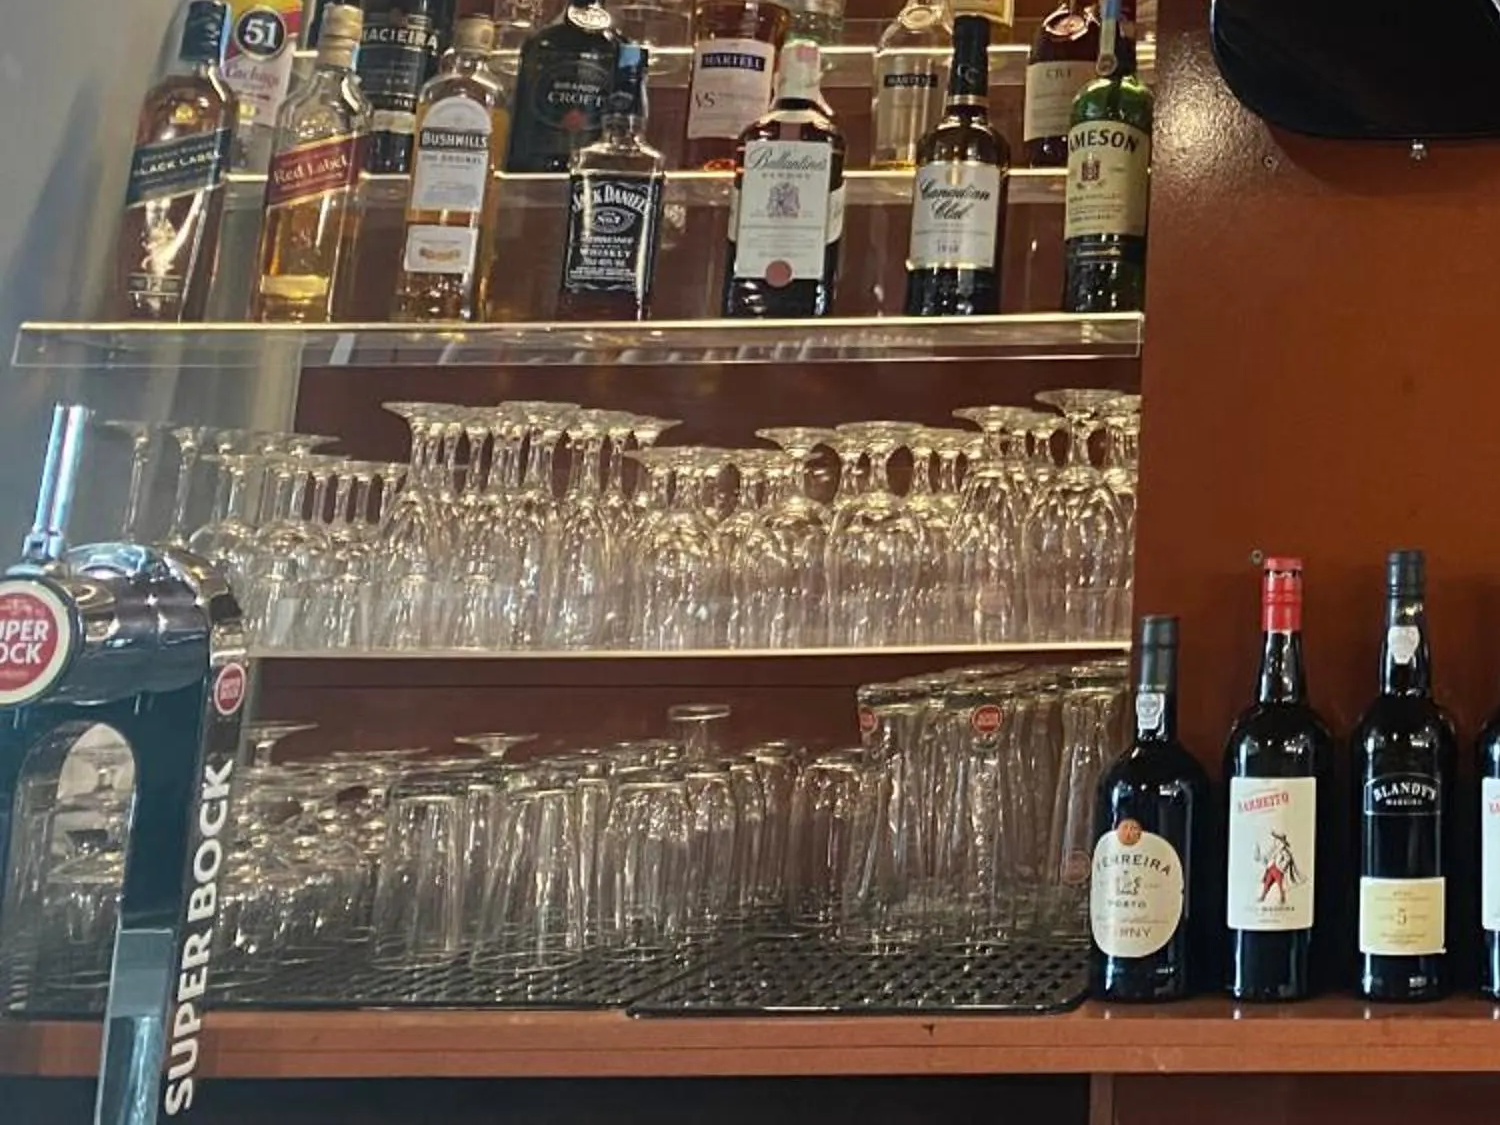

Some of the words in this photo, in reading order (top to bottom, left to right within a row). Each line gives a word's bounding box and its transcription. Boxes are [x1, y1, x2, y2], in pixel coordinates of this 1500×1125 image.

[244, 17, 278, 48] 51
[421, 130, 488, 149] BUSHMILLS
[1069, 128, 1140, 153] AMESON
[180, 148, 223, 167] LABEL
[273, 164, 305, 186] Red
[308, 153, 350, 177] Label
[572, 188, 602, 213] JK
[603, 184, 649, 215] DANIEL
[0, 642, 43, 664] OCK
[187, 757, 235, 924] BOCK
[1096, 853, 1172, 877] FEREIRA
[165, 926, 213, 1116] SUPER
